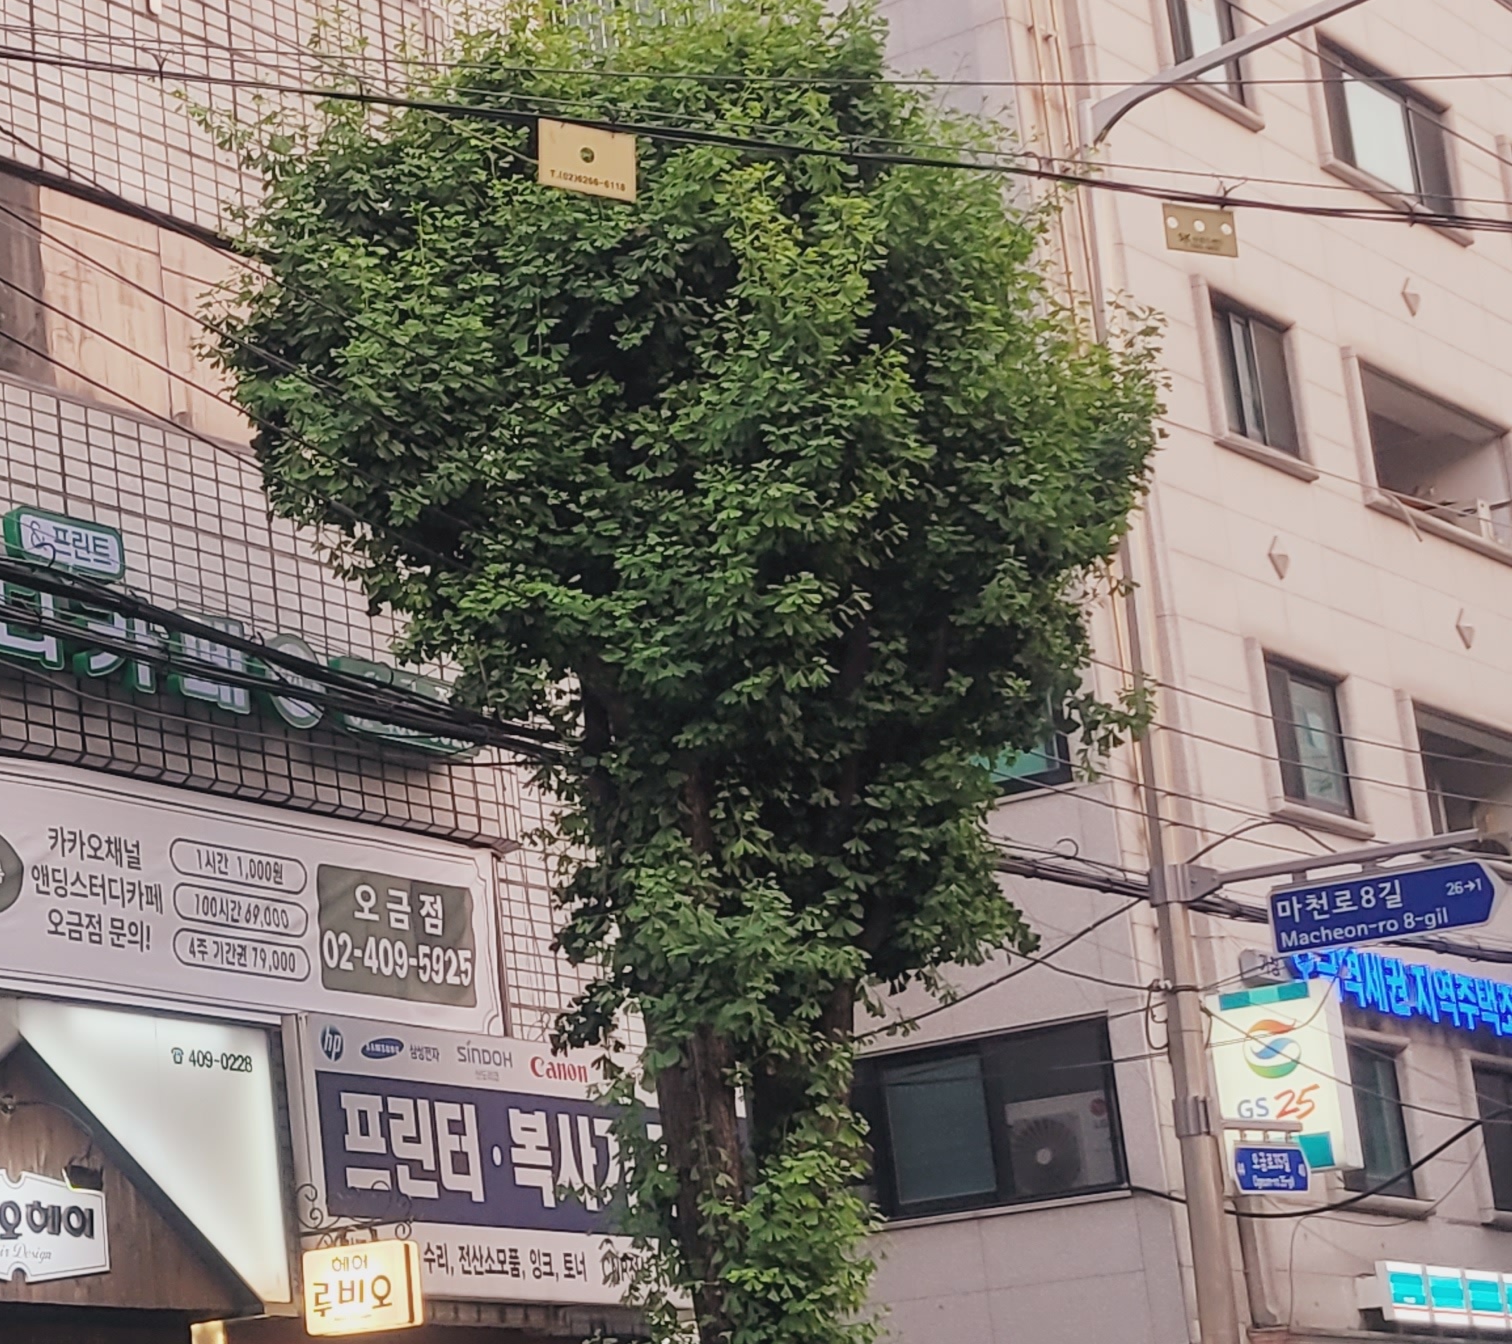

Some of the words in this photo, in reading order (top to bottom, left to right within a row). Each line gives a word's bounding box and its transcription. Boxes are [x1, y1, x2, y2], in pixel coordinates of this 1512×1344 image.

[53, 522, 112, 561] 프린트
[47, 826, 142, 870] 카카오채널
[196, 848, 231, 878] 1시간
[235, 852, 284, 885] 1,000원
[30, 866, 164, 916] 앤딩스터디카페
[193, 892, 243, 923] 100시간
[243, 897, 290, 930] 69,000
[353, 883, 445, 936] 오금점
[1276, 879, 1404, 923] 마천로8길
[46, 907, 105, 947] 오금점
[108, 917, 152, 952] 문의!
[1280, 918, 1399, 949] Macheon-ro
[1402, 907, 1449, 930] 8-gil
[188, 937, 208, 961] 4주
[211, 939, 249, 968] 기간권
[250, 943, 297, 976] 79,000
[322, 930, 473, 988] 02-409-5925
[188, 1049, 254, 1074] 409-0228
[324, 1027, 342, 1061] hp
[364, 1041, 400, 1055] SAMSUNG
[409, 1042, 440, 1063] 삼성전자
[529, 1055, 588, 1084] Canon
[13, 1242, 53, 1264] Design
[330, 1253, 370, 1274] 헤어
[423, 1241, 455, 1277] 수리,
[458, 1244, 526, 1281] 전산소모품,
[529, 1248, 560, 1283] 잉크,
[563, 1251, 588, 1282] 토너
[312, 1273, 393, 1316] 루비오
